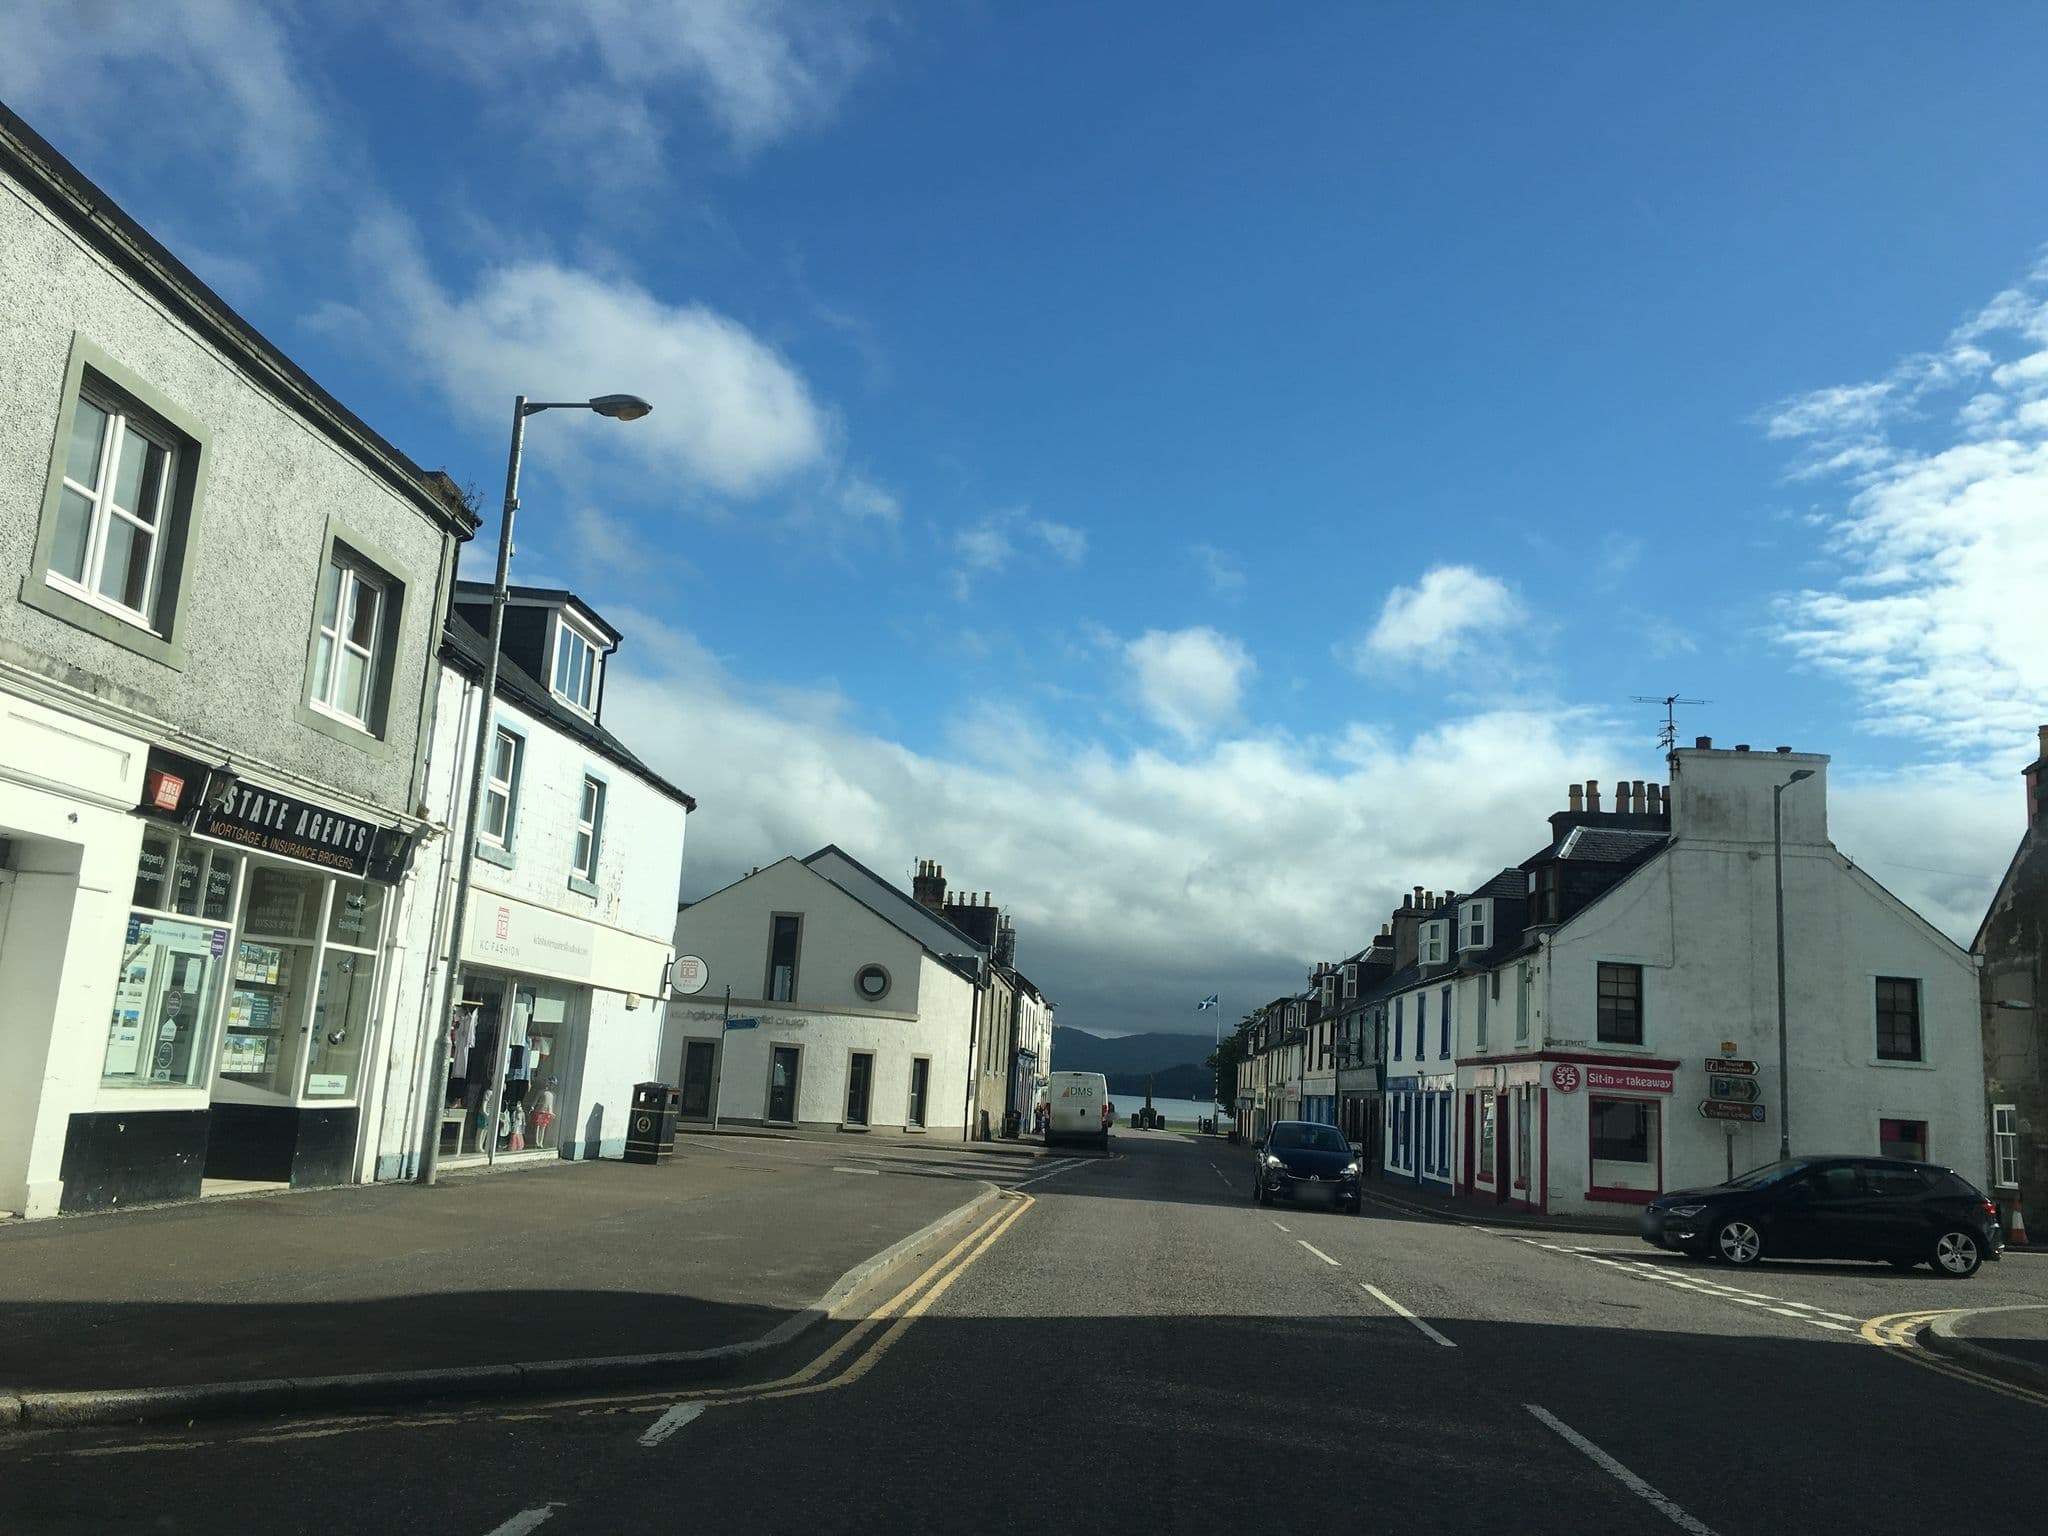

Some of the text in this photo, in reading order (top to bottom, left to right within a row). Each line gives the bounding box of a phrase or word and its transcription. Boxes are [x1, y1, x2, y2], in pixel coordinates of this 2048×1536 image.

[222, 785, 367, 852] STATE AGENTS
[209, 820, 354, 870] MORTGAGE & INSURANCE BROKERS
[140, 850, 165, 868] Property
[176, 859, 199, 878] Property
[209, 867, 231, 885] Property
[210, 882, 226, 896] Sales
[479, 939, 490, 952] KC
[491, 942, 520, 957] FASHION
[1555, 1073, 1577, 1086] 35
[1626, 1076, 1672, 1088] takeaway
[1070, 1086, 1093, 1097] DMS
